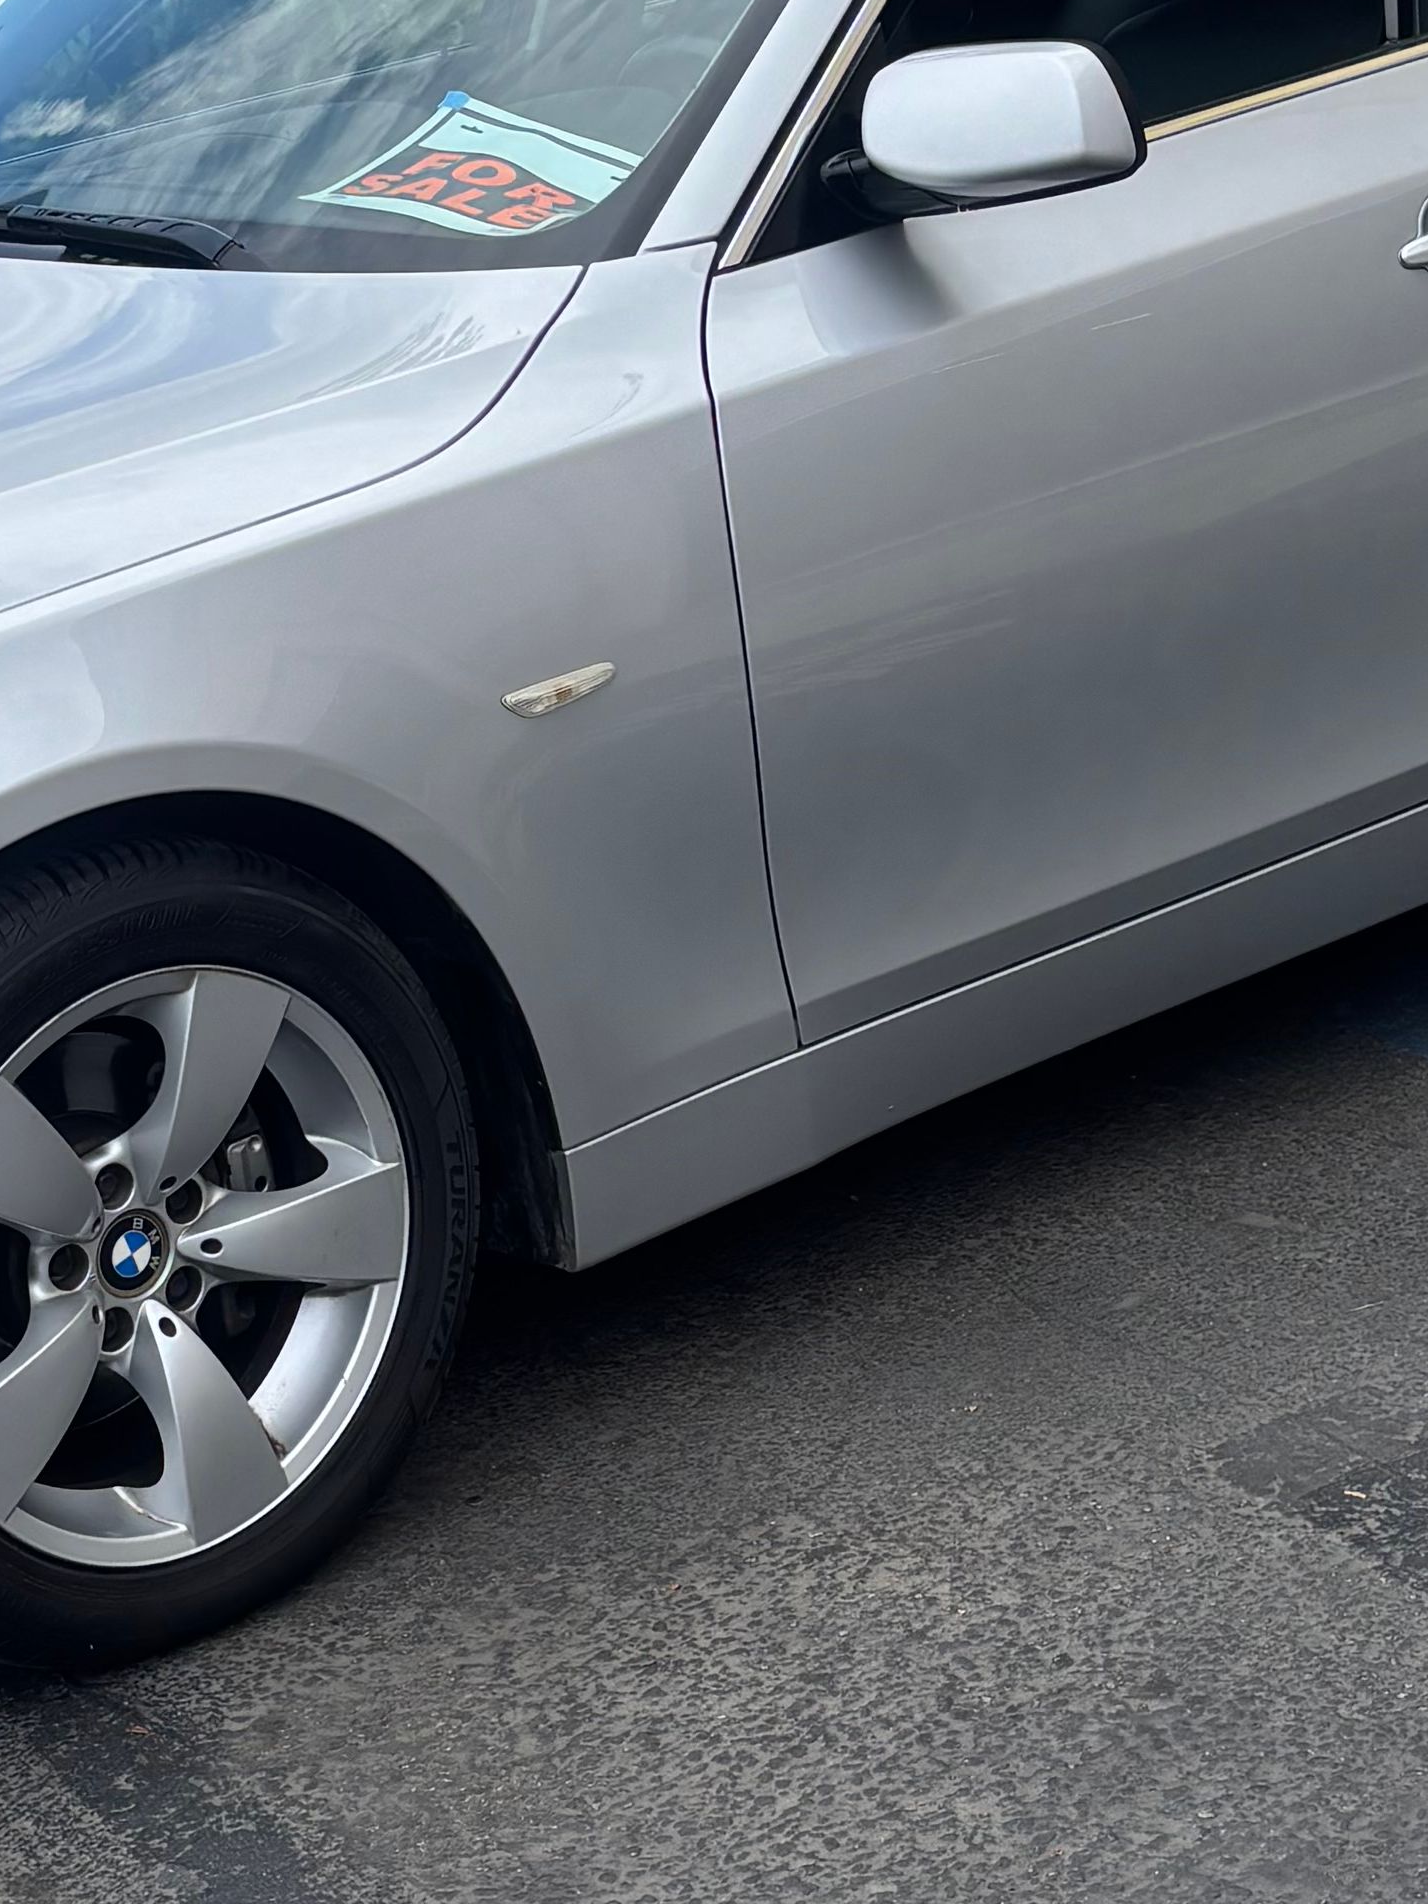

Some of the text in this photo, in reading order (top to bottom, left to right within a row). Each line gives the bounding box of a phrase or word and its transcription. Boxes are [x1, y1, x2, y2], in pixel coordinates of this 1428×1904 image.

[342, 172, 556, 229] SALE
[401, 151, 577, 211] FOR
[425, 1130, 469, 1371] TURANZA
